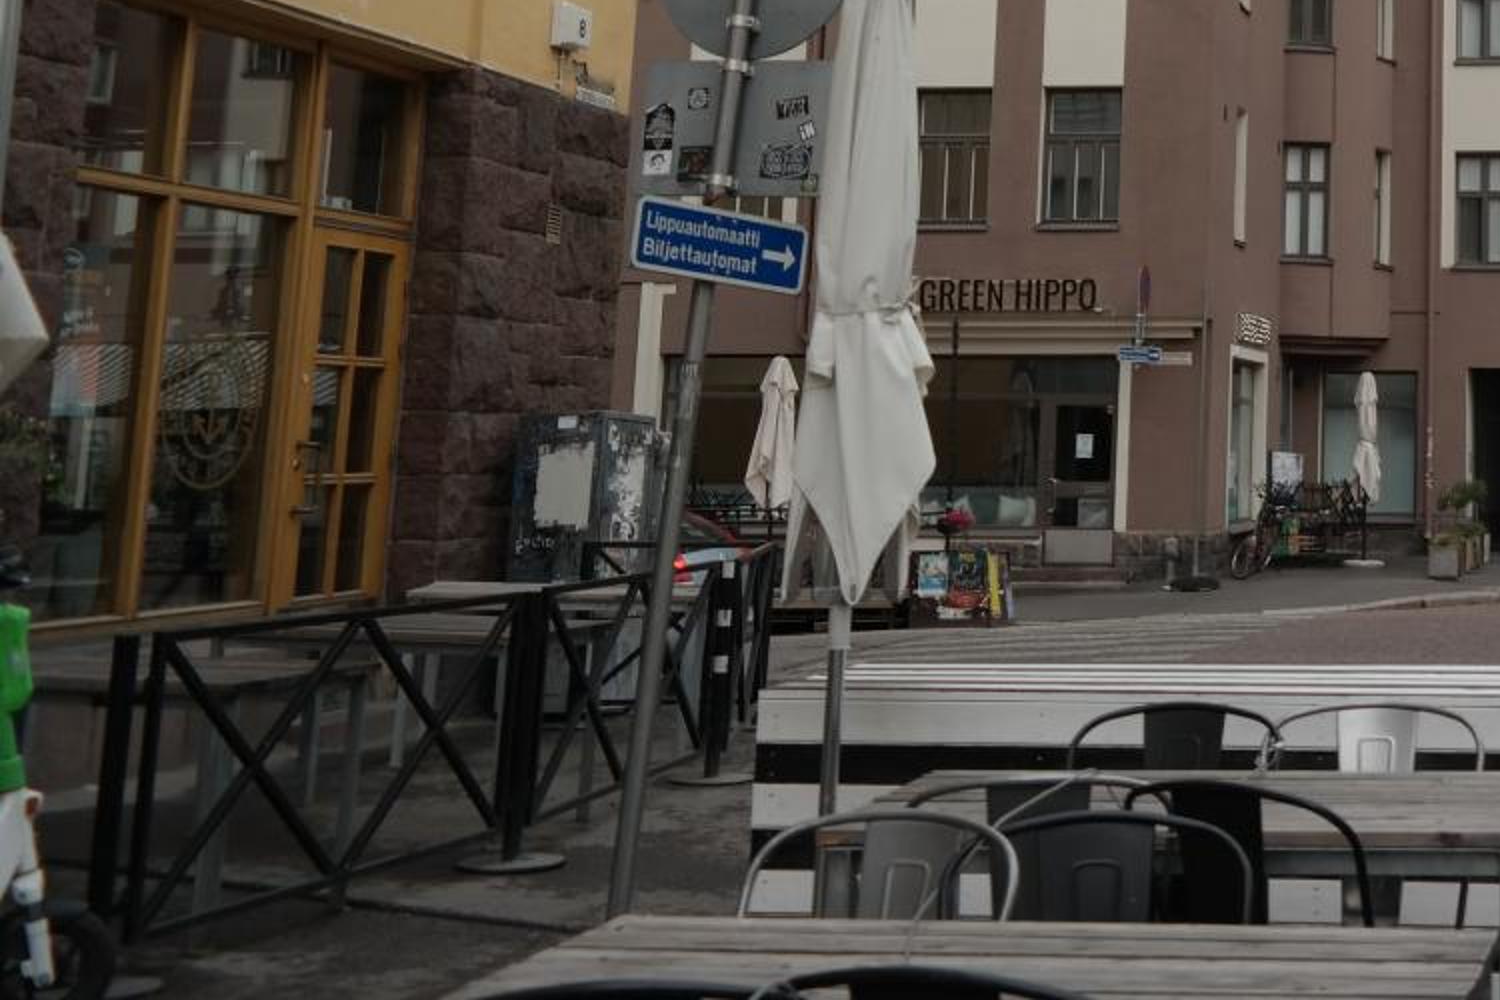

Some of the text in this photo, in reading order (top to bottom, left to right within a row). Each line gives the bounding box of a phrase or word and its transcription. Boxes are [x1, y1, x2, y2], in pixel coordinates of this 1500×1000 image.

[645, 209, 761, 248] Lippuautomaatti
[642, 237, 757, 276] Biljettautomat
[919, 278, 1098, 313] GREEN HIPPO
